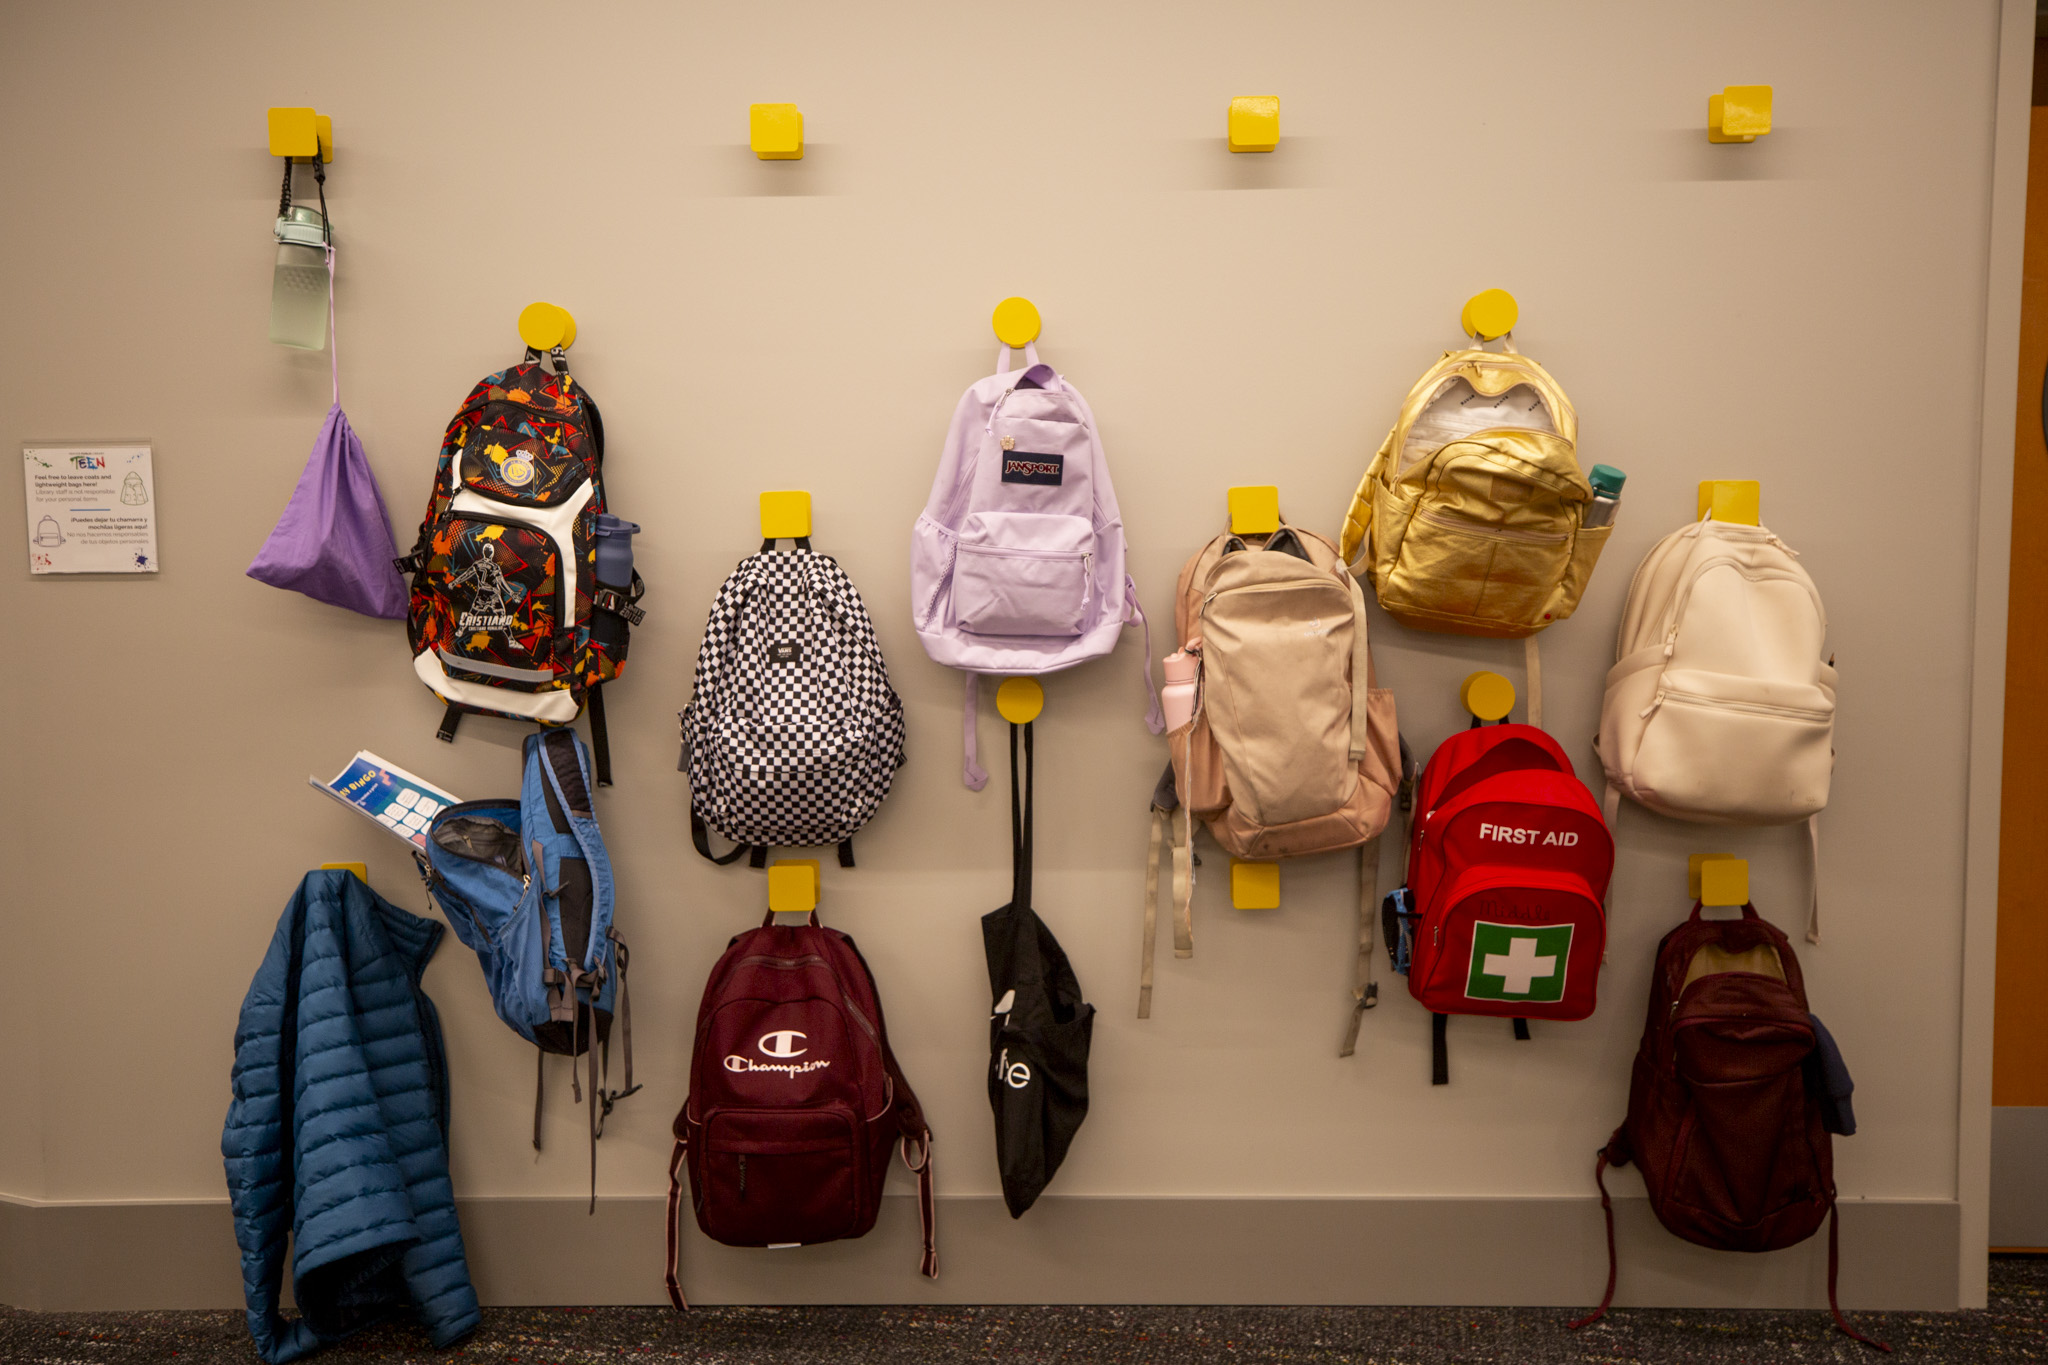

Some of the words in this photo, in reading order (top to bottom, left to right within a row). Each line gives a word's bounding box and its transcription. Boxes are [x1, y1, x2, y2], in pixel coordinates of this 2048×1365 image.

[70, 456, 106, 470] TEEN
[1005, 460, 1059, 476] JANSPORT
[459, 612, 514, 626] CRISTIANO
[1479, 822, 1540, 845] FIRST
[1542, 831, 1579, 846] AID
[723, 1054, 831, 1079] Champion
